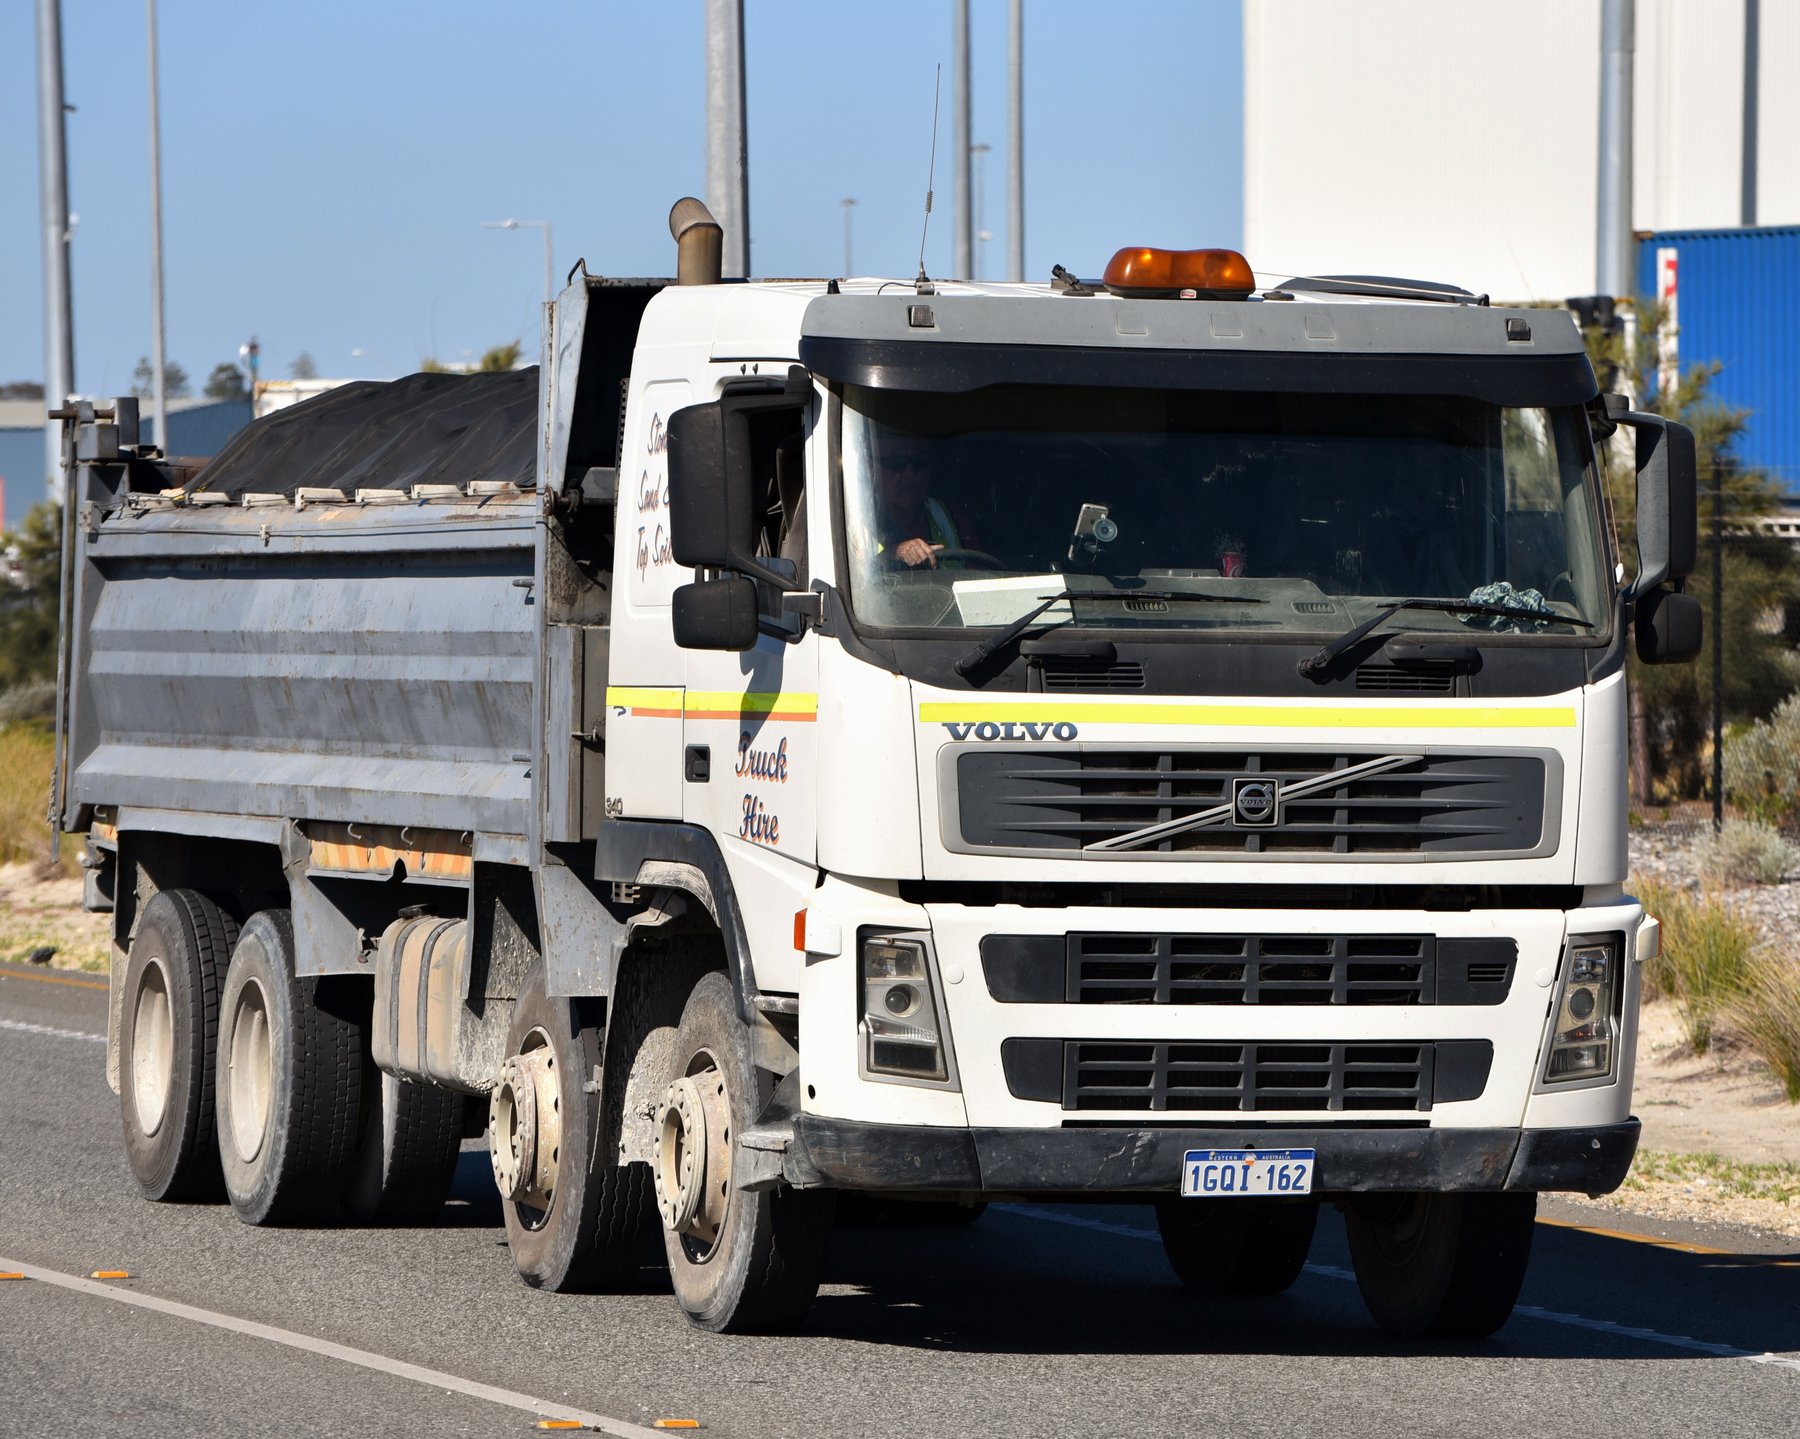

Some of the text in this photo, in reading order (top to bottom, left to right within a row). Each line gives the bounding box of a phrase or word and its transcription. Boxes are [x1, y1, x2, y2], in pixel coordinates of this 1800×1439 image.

[638, 469, 661, 513] Sand
[637, 526, 648, 584] Top
[942, 722, 1078, 741] VOLVO
[735, 730, 788, 784] Truck
[606, 797, 623, 815] 340
[739, 793, 779, 845] Hire
